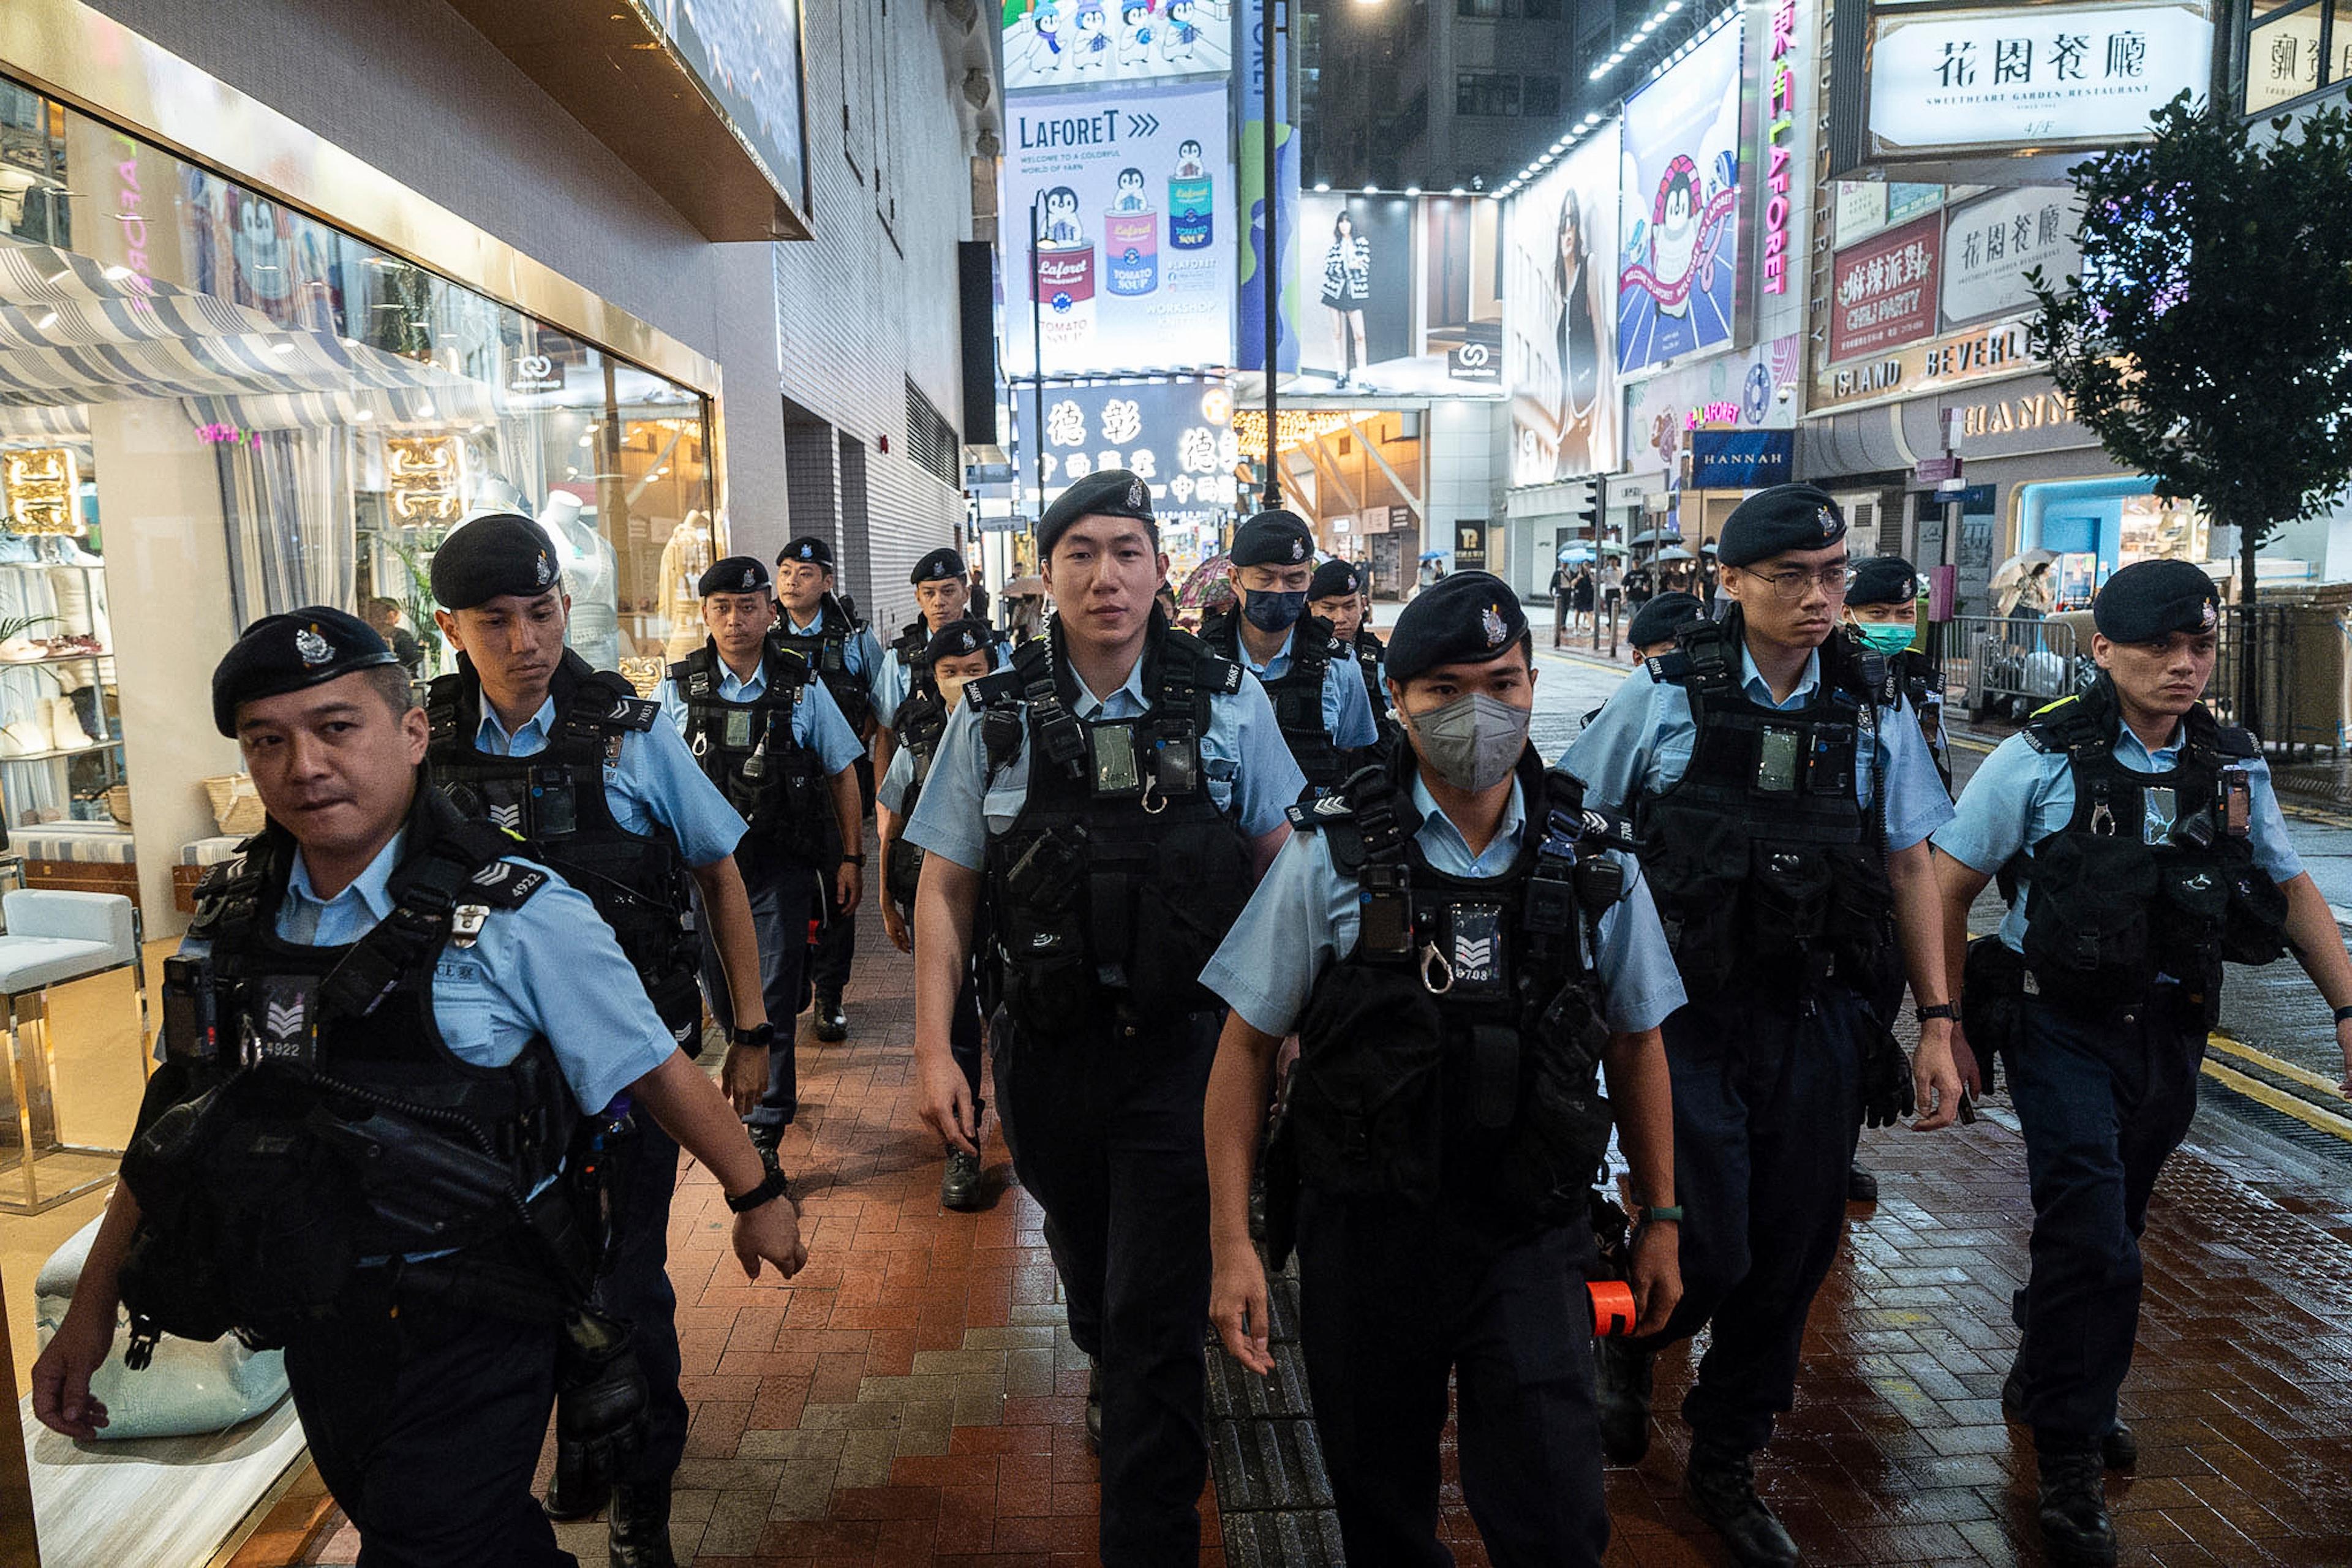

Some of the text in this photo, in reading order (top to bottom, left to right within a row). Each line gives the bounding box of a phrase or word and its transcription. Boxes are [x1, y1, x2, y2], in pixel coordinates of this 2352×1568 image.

[1932, 30, 2147, 88] 花園餐廳
[1926, 84, 2149, 106] SWEETHEART GARDEN RESTAURANT
[1020, 154, 1058, 164] WELCOME
[1020, 165, 1049, 174] WORLD
[1763, 119, 1792, 295] LAFORET
[1112, 267, 1153, 279] TOMATO
[1117, 277, 1149, 290] SOUP
[1878, 287, 1921, 322] PARTY
[1831, 358, 1901, 399] ISLAND
[1705, 454, 1782, 464] HANNAH
[1225, 664, 1242, 688] 26687
[511, 872, 541, 898] 4922
